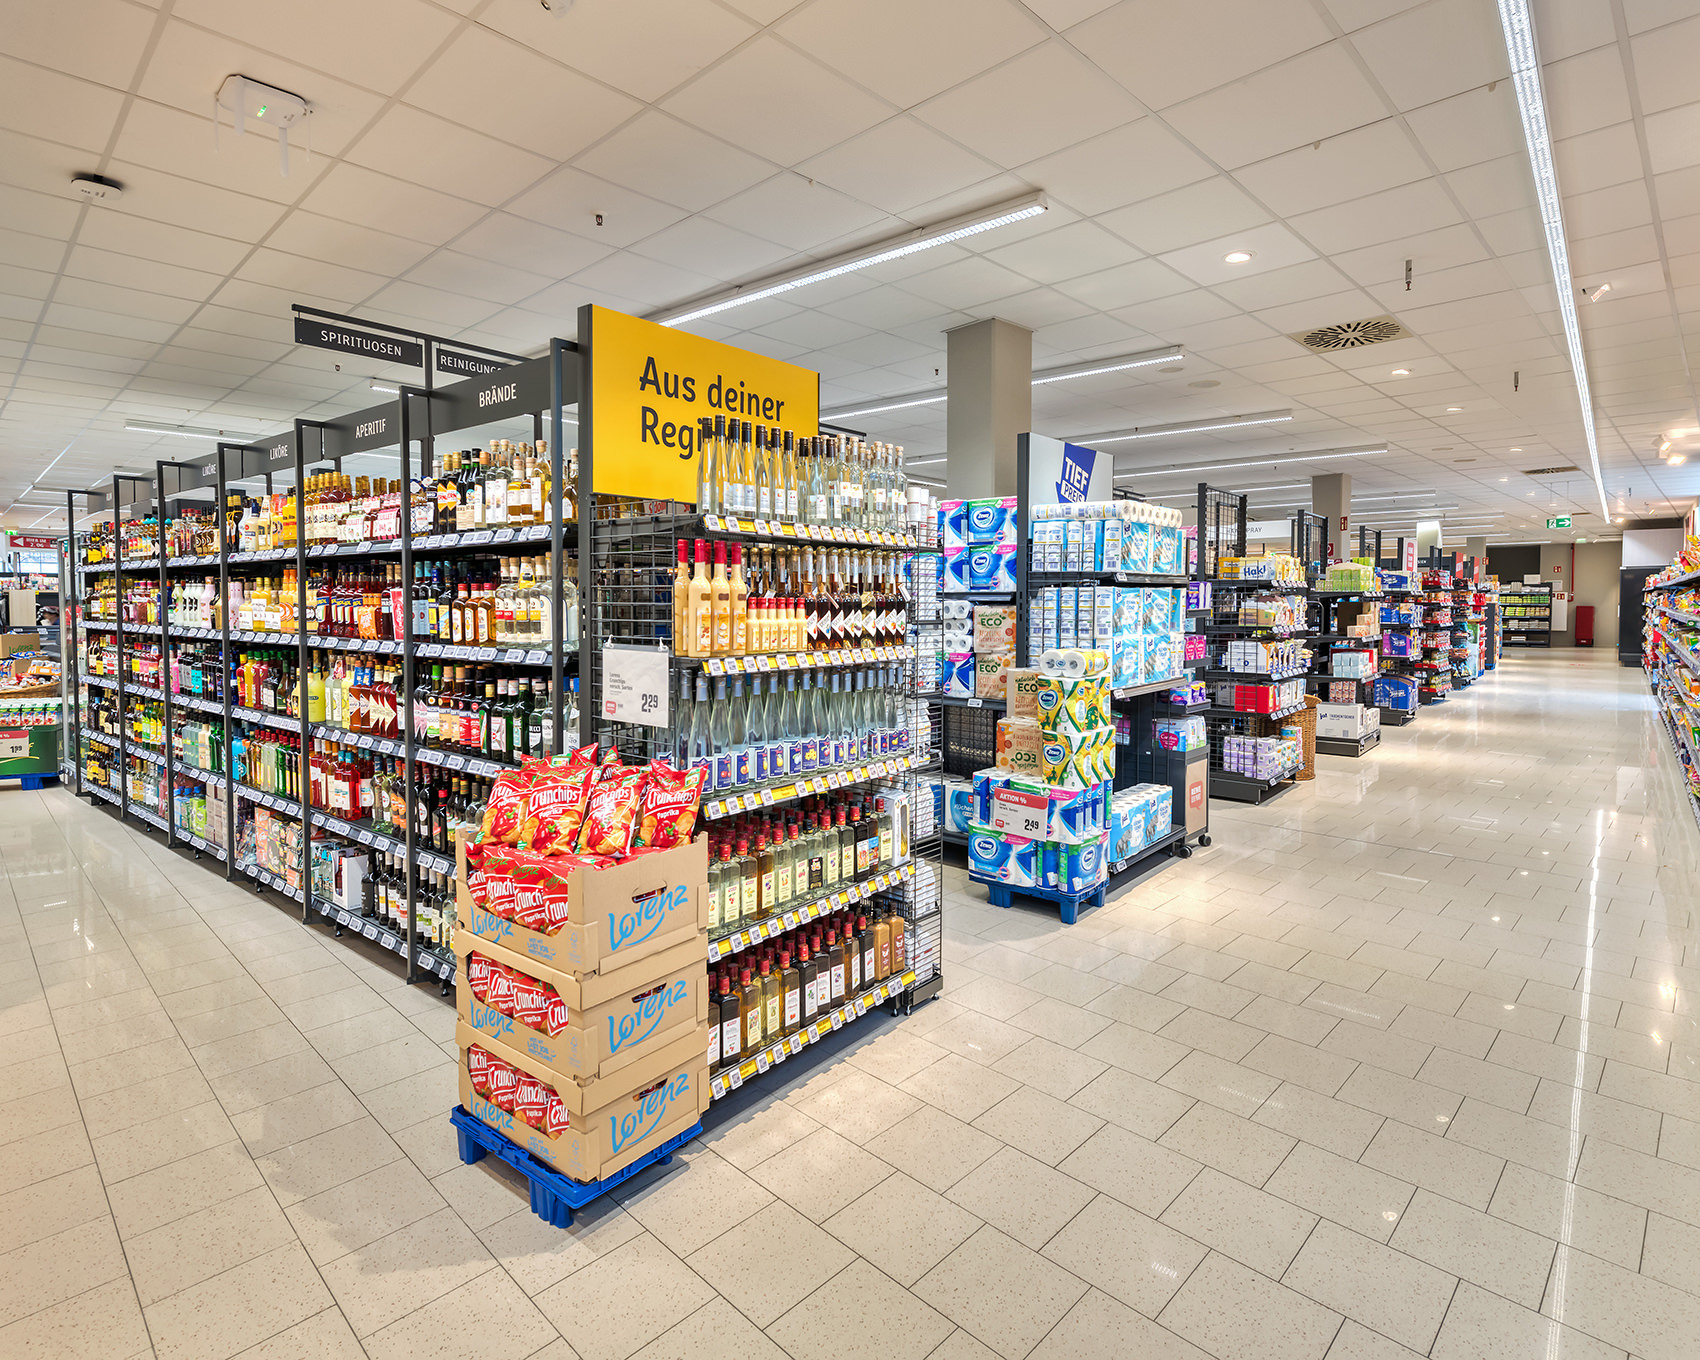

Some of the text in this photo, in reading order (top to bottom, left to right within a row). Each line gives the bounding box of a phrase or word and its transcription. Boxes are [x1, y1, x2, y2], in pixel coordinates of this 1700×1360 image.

[320, 329, 402, 357] SPIRITUOSEN
[440, 354, 502, 374] REINIGUN
[479, 383, 517, 407] BRÄNDE
[639, 356, 784, 421] Aus deiner
[355, 418, 387, 439] APERITIF
[641, 405, 722, 460] Regi
[269, 444, 288, 460] LIKÖRE
[1065, 456, 1089, 492] TIEF
[1064, 483, 1083, 503] PREIS
[980, 618, 1002, 627] ECO
[979, 664, 998, 673] ECO
[1017, 683, 1038, 692] ECO
[641, 693, 659, 713] 2.29
[1015, 751, 1037, 761] ECO
[529, 786, 578, 812] Crunchips
[999, 793, 1019, 803] AKTION
[1024, 818, 1039, 832] 2.49
[515, 888, 544, 912] Crunchi
[470, 906, 514, 940] Lorenz
[608, 884, 688, 951] Lorenz
[514, 988, 549, 1011] Crunchip
[470, 1000, 515, 1037] Lorenz
[607, 980, 688, 1054] Lorenz
[516, 1081, 550, 1104] Crunchip
[470, 1092, 515, 1131] Lorenz
[610, 1073, 690, 1153] Lorenz
